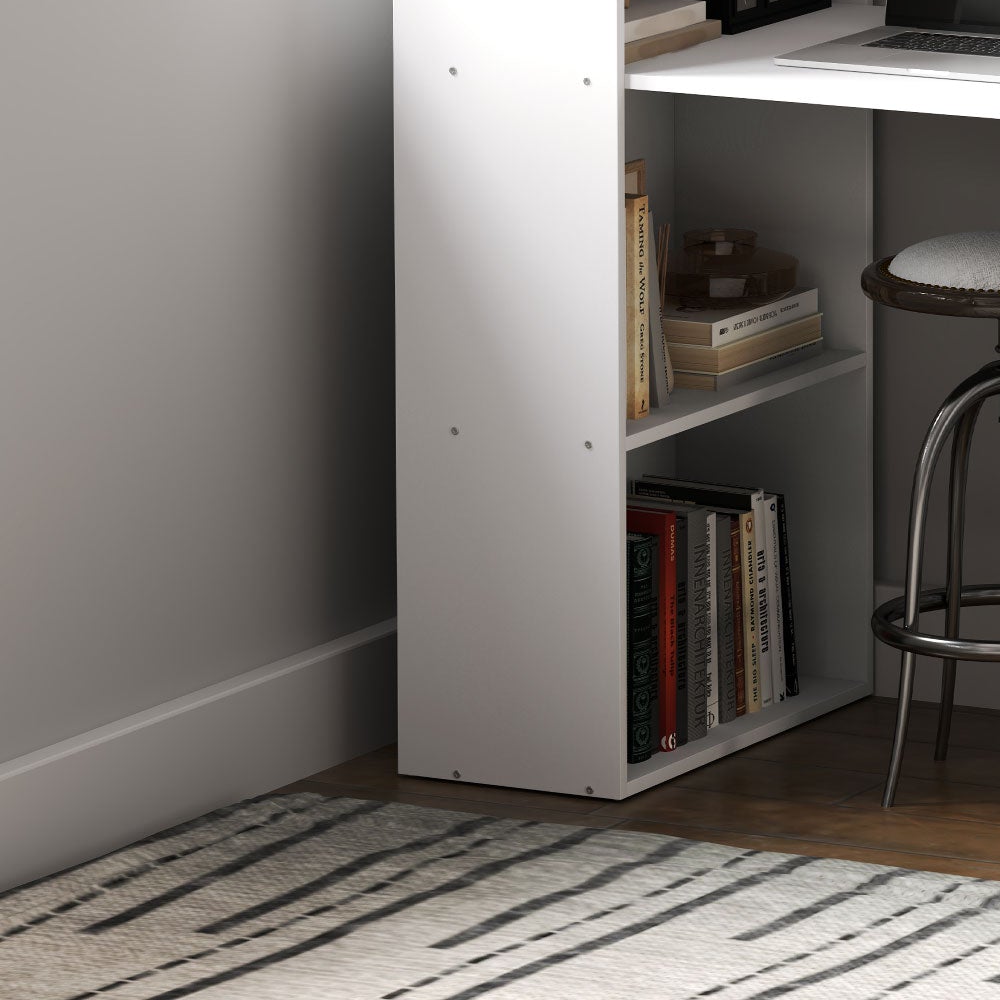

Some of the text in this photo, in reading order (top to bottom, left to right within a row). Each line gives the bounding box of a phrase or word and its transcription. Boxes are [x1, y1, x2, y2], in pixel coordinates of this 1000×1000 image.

[756, 550, 766, 571] arts
[694, 544, 707, 728] INNENARCHITEKTUR
[722, 550, 735, 712] INNENARCHITEKTUR
[758, 588, 768, 653] architecture
